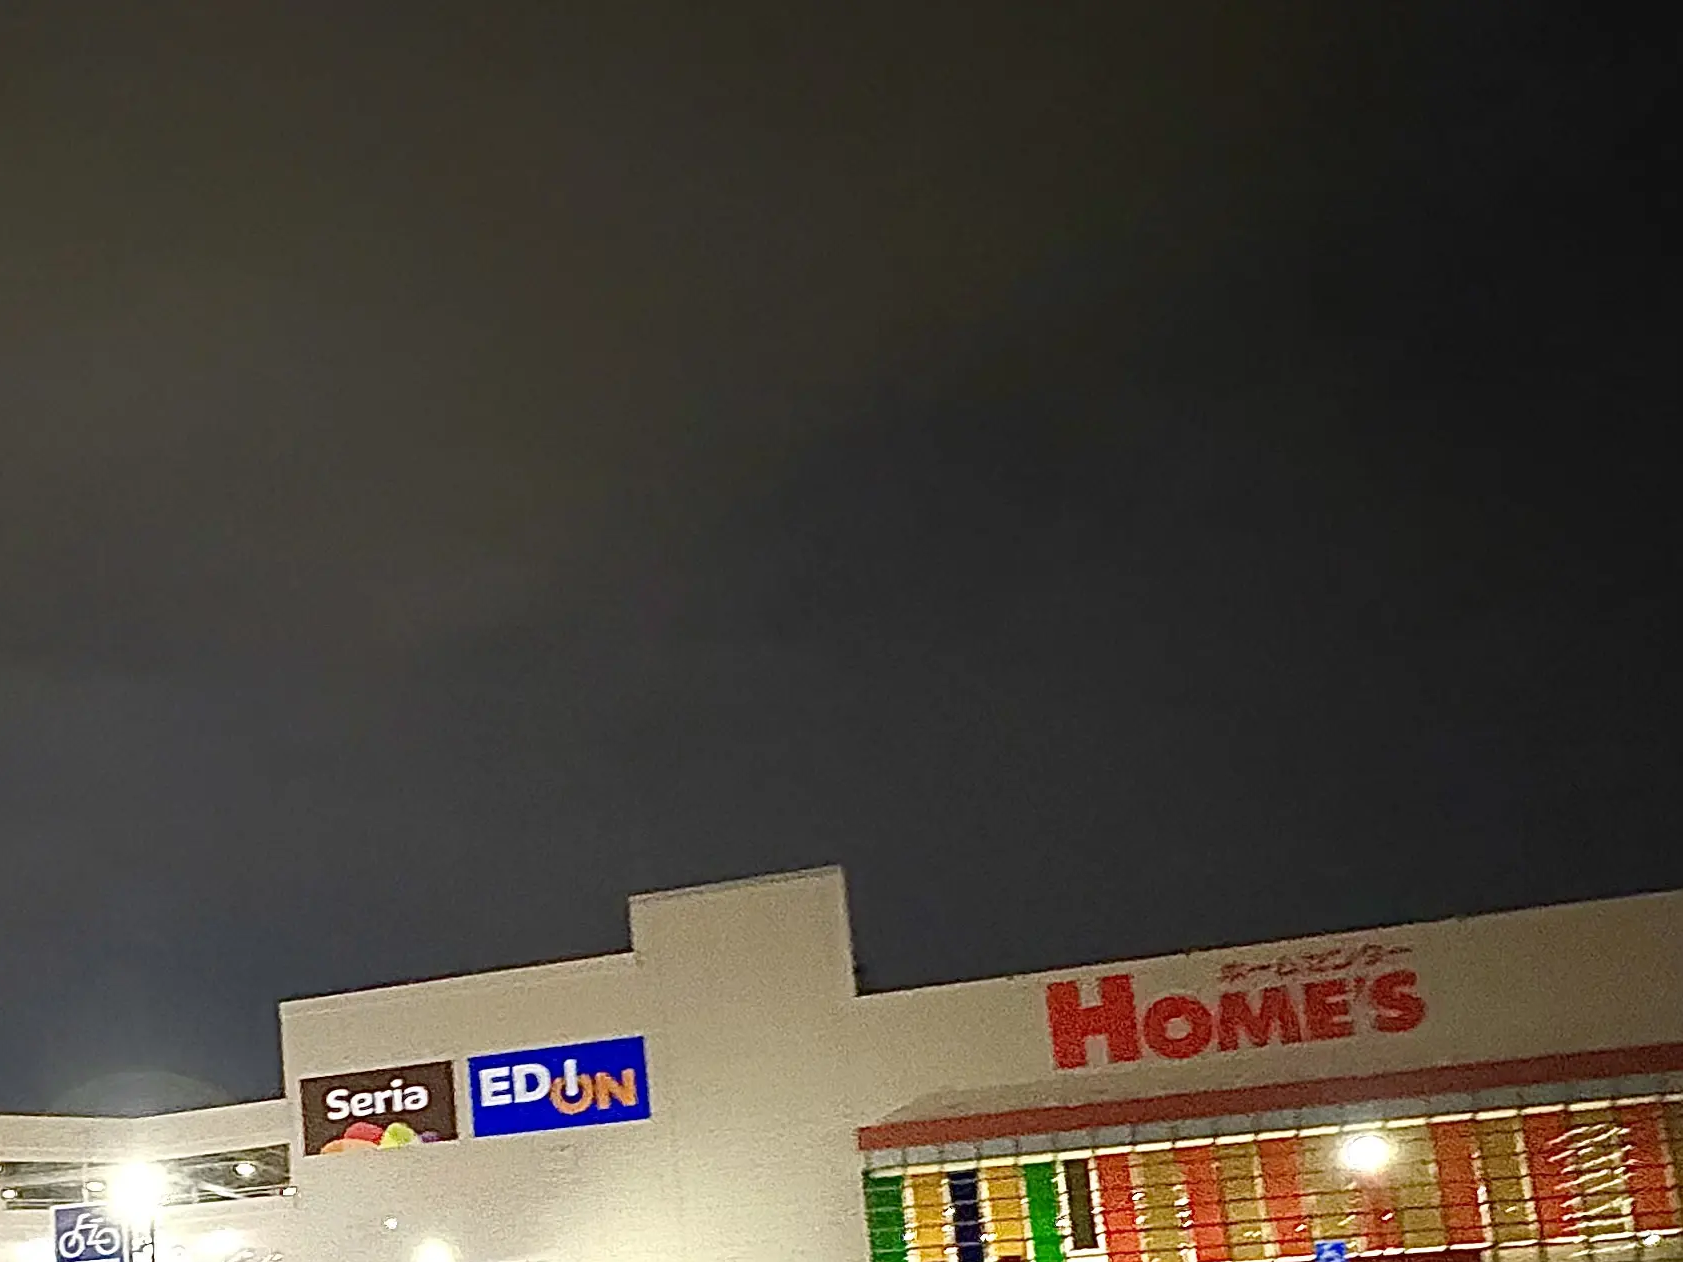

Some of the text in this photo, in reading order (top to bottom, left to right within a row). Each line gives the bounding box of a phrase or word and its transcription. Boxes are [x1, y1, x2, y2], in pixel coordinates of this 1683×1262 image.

[1047, 970, 1426, 1070] HOME'S
[326, 1079, 429, 1121] Seria
[478, 1058, 637, 1115] EDION
